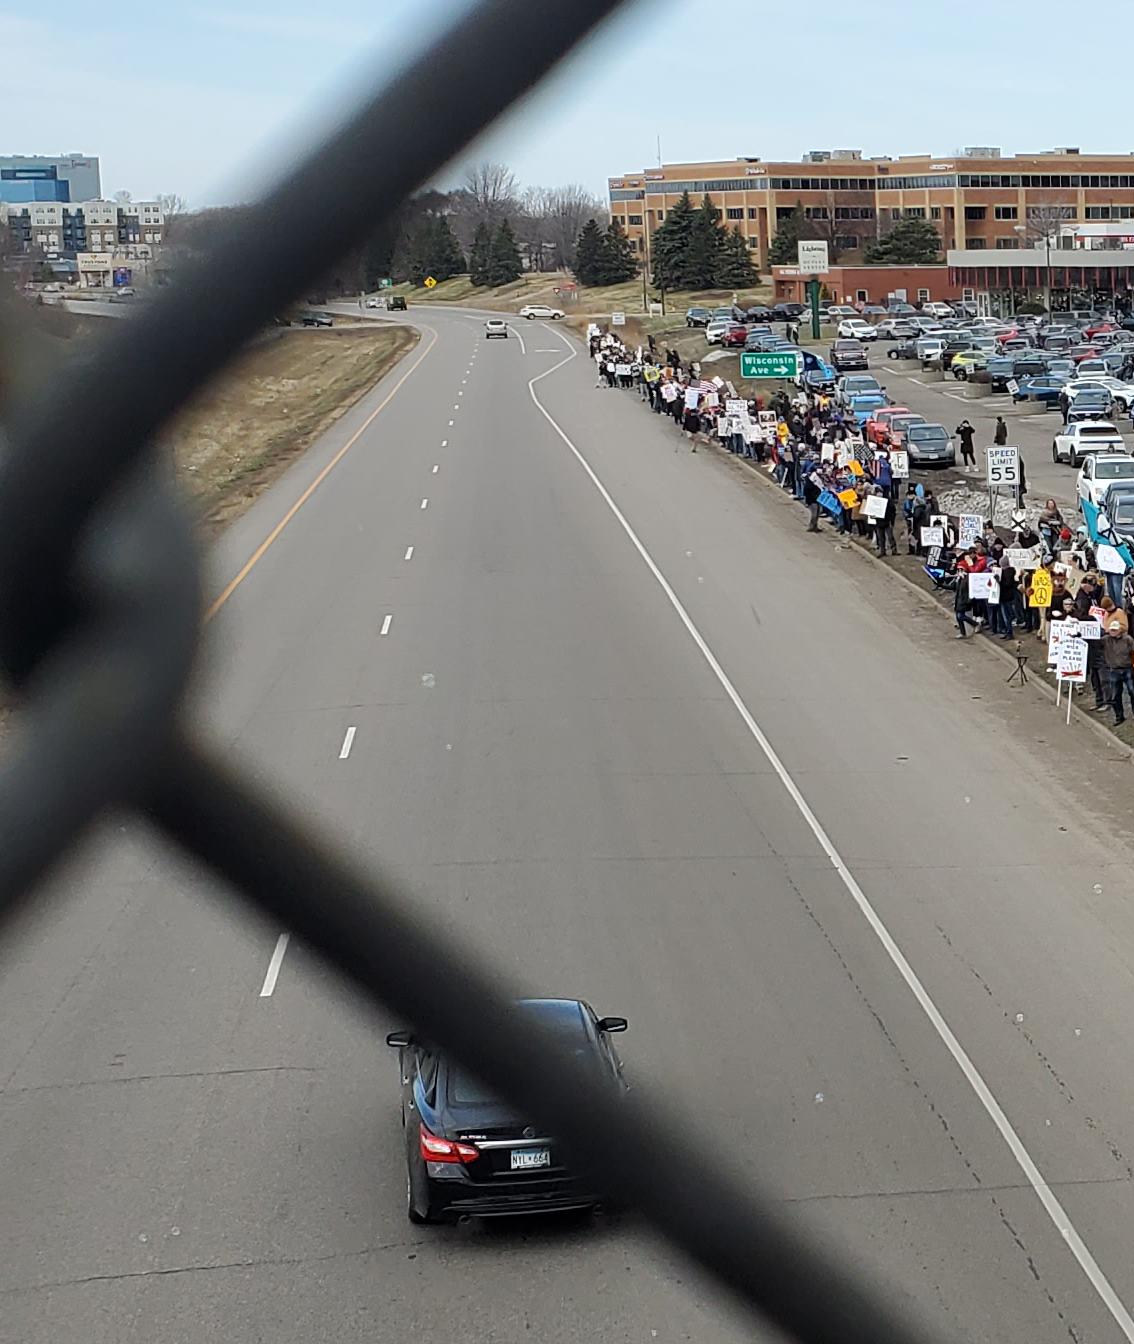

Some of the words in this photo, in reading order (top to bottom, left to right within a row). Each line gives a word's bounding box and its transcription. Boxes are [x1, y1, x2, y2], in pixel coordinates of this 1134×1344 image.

[743, 356, 794, 365] Wisconsin
[750, 366, 769, 375] Ave
[989, 449, 1016, 458] SPEED
[992, 458, 1013, 466] LIMIT
[991, 467, 1016, 481] 55
